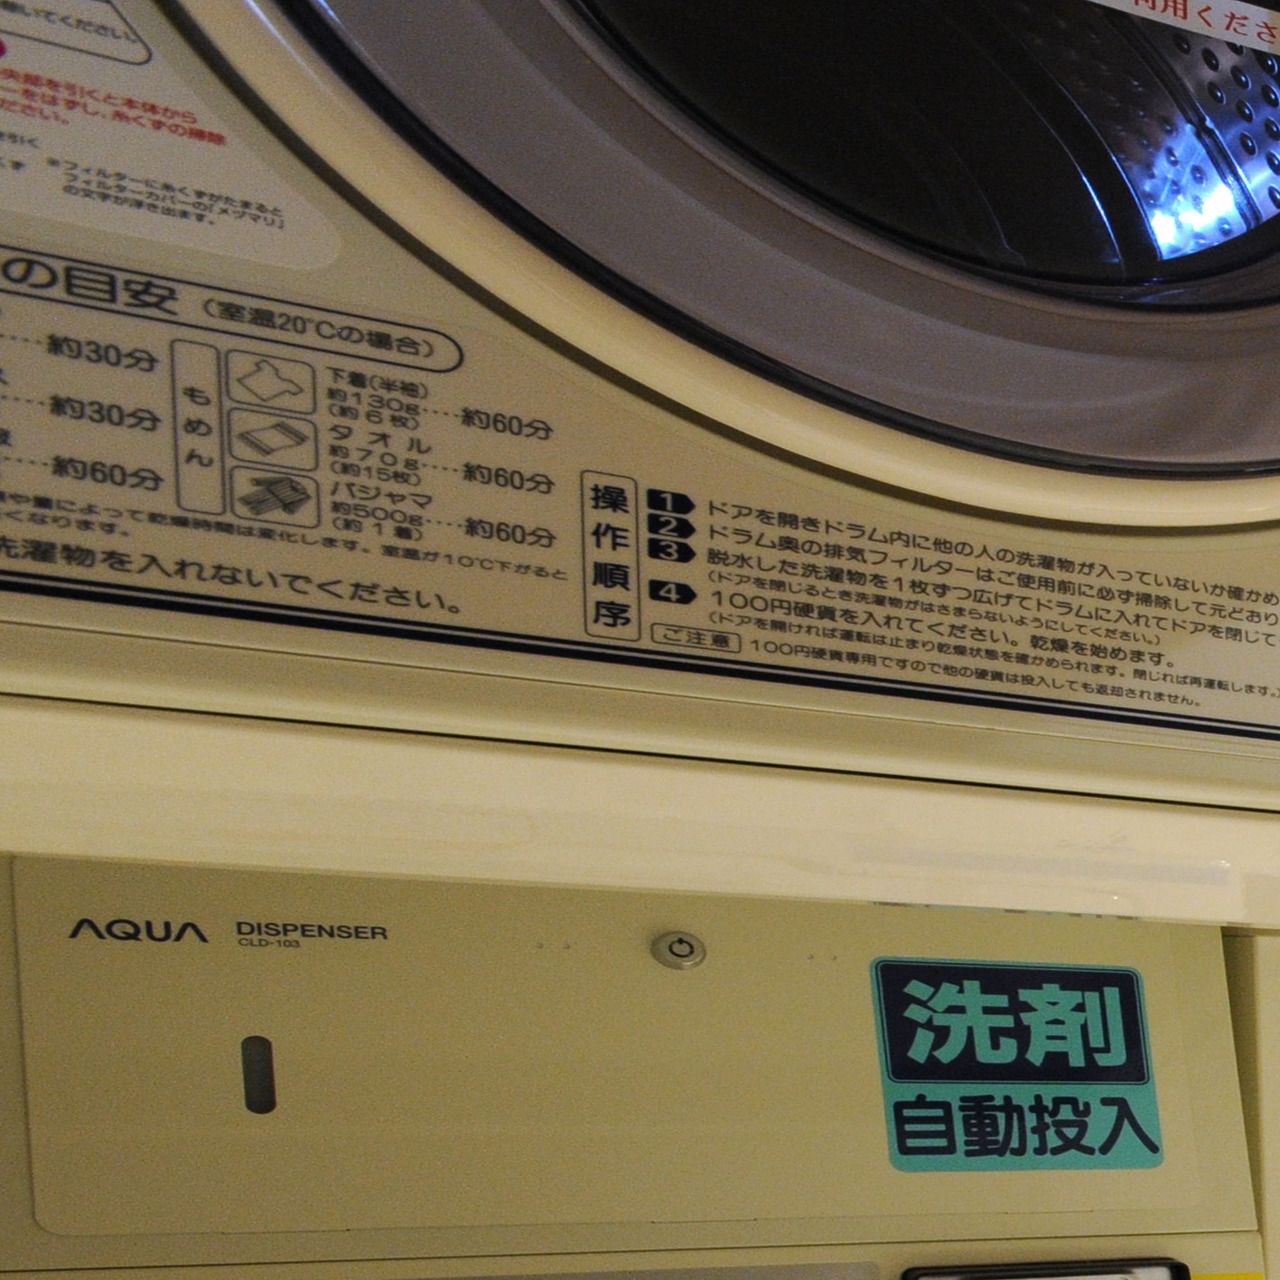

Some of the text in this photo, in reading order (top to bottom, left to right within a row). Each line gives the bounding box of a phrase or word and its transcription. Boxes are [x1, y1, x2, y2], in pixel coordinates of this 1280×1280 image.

[47, 332, 160, 373] 約30分
[51, 393, 162, 433] 約30分
[182, 386, 214, 468] もめん
[461, 405, 555, 442] 約60分
[52, 455, 166, 492] 約60分
[462, 461, 558, 497] 約60分
[463, 516, 559, 550] 約60分
[589, 484, 632, 628] 操作順序
[659, 583, 680, 603] 4
[661, 627, 731, 649] ご注意
[68, 918, 388, 943] AQUA DISPENSER
[902, 979, 1128, 1067] 洗剤
[892, 1093, 1161, 1158] 自動投入
